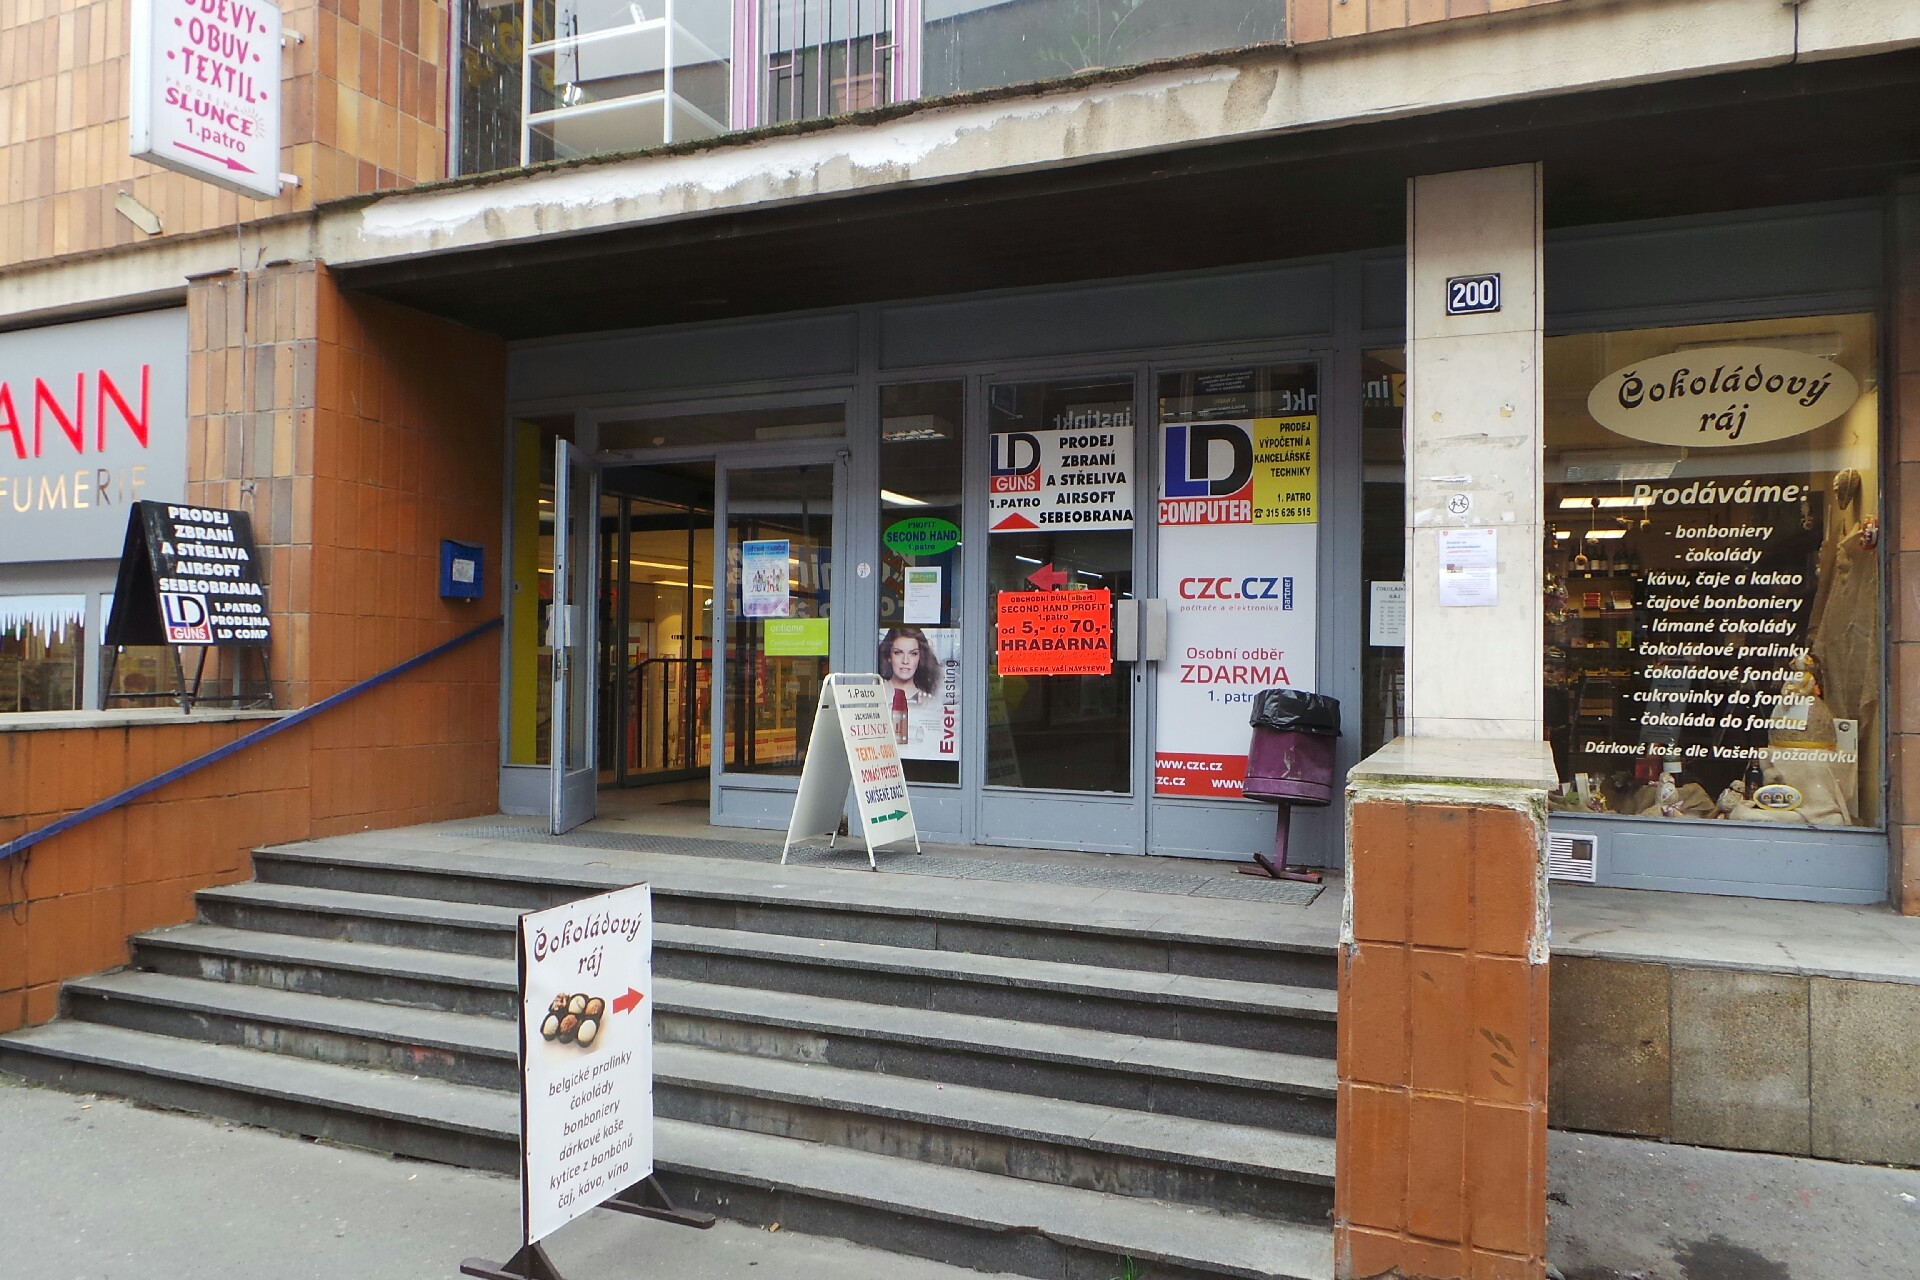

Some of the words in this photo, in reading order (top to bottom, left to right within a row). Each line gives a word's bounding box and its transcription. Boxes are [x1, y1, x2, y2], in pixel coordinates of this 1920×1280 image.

[189, 17, 249, 64] OBUV
[182, 47, 256, 104] TEXTIL
[165, 87, 253, 137] SLUNCE
[186, 118, 246, 153] 1.patro
[1452, 280, 1493, 308] 200
[1618, 364, 1832, 410] Čokoládový
[1280, 422, 1311, 433] PRODEJ
[1699, 403, 1750, 440] ráj
[1059, 435, 1114, 449] PRODEJ
[1259, 434, 1304, 449] VÝPOČETNÍ
[990, 433, 1042, 476] LD
[1061, 450, 1116, 468] ZBRANÍ
[1165, 424, 1254, 497] LD
[1254, 449, 1311, 464] KANCELÁŘSKÉ
[1046, 474, 1057, 486] A
[1060, 469, 1127, 486] STŘELIVA
[1271, 467, 1311, 477] TECHNIKY
[996, 475, 1036, 492] GUNS
[1056, 491, 1116, 505] AIRSOFT
[1277, 494, 1284, 502] 1.
[1286, 492, 1311, 502] PATRO
[1632, 480, 1809, 505] Prodáváme:
[990, 498, 1041, 509] 1.PATRO
[1158, 500, 1252, 524] COMPUTER
[1266, 508, 1279, 517] 315
[1282, 508, 1295, 517] 626
[1298, 507, 1311, 516] 515
[168, 506, 229, 525] PRODEJ
[1039, 509, 1134, 524] SEBEOBRANA
[174, 525, 235, 542] ZBRANÍ
[887, 531, 927, 542] SECOND
[930, 530, 957, 541] HAND
[1675, 524, 1773, 540] bonboniery
[161, 542, 175, 555] A
[177, 541, 249, 561] STŘELIVA
[908, 544, 935, 552] 1.patro
[1685, 548, 1762, 564] čokolády
[176, 561, 240, 577] AIRSOFT
[159, 578, 262, 595] SEBEOBRANA
[1647, 572, 1691, 587] kávu,
[1696, 572, 1731, 588] čaje
[1735, 575, 1746, 585] a
[1751, 571, 1802, 585] kakao
[1179, 577, 1279, 600] CZC.CZ
[1283, 578, 1293, 610] partner
[1010, 595, 1049, 603] OBCHODNÍ
[1051, 594, 1067, 602] DŮM
[1072, 603, 1106, 611] PROFIT
[1646, 595, 1700, 612] čajové
[1703, 595, 1803, 612] bonboniery
[163, 595, 206, 628] LD
[214, 602, 262, 613] 1.PATRO
[1180, 604, 1217, 612] počítače
[1229, 604, 1279, 612] elektronika
[210, 615, 270, 626] PRODEJNA
[1652, 619, 1715, 633] lámané
[1719, 618, 1797, 636] čokolády
[174, 628, 206, 640] GUNS
[217, 629, 233, 639] LD
[235, 629, 268, 639] COMP
[1001, 626, 1015, 634] od
[1052, 625, 1066, 634] do
[1001, 635, 1108, 651] HRABÁRNA
[1639, 642, 1734, 657] čokoládové
[1738, 643, 1810, 659] pralinky
[1186, 647, 1237, 660] Osobní
[1242, 647, 1285, 661] odběr
[1180, 665, 1291, 685] ZDARMA
[1644, 665, 1739, 681] čokoládové
[1741, 667, 1804, 683] fondue
[848, 688, 875, 699] 1.Patro
[1208, 690, 1220, 702] 1.
[1224, 692, 1255, 705] patr
[1633, 689, 1724, 706] cukrovinky
[1727, 690, 1750, 705] do
[1752, 690, 1815, 708] fondue
[850, 723, 888, 737] SLUNCE
[1640, 711, 1715, 728] čokoláda
[1719, 714, 1742, 729] do
[1745, 714, 1807, 732] fondue
[855, 747, 878, 762] TEXTIL
[880, 744, 896, 759] OBUV
[1585, 741, 1645, 755] Dárkové
[1649, 743, 1682, 757] koše
[1686, 745, 1709, 758] dle
[1713, 745, 1768, 760] Vašeho
[1771, 747, 1857, 764] požadavku
[861, 763, 880, 783] DOMÁCÍ
[1155, 776, 1186, 786] zc.cz
[534, 910, 642, 963] Čokoládový
[578, 945, 604, 977] ráj
[549, 1065, 589, 1096] belgické
[592, 1051, 632, 1080] pralinky
[570, 1080, 614, 1110] čokolády
[563, 1099, 620, 1137] bonboniery
[559, 1130, 601, 1161] dárkové
[603, 1119, 624, 1139] koše
[550, 1165, 581, 1191] kytice
[583, 1162, 588, 1172] z
[591, 1132, 634, 1167] bonbónů
[558, 1191, 576, 1208] čaj,
[578, 1174, 605, 1198] káva,
[607, 1161, 629, 1179] víno
